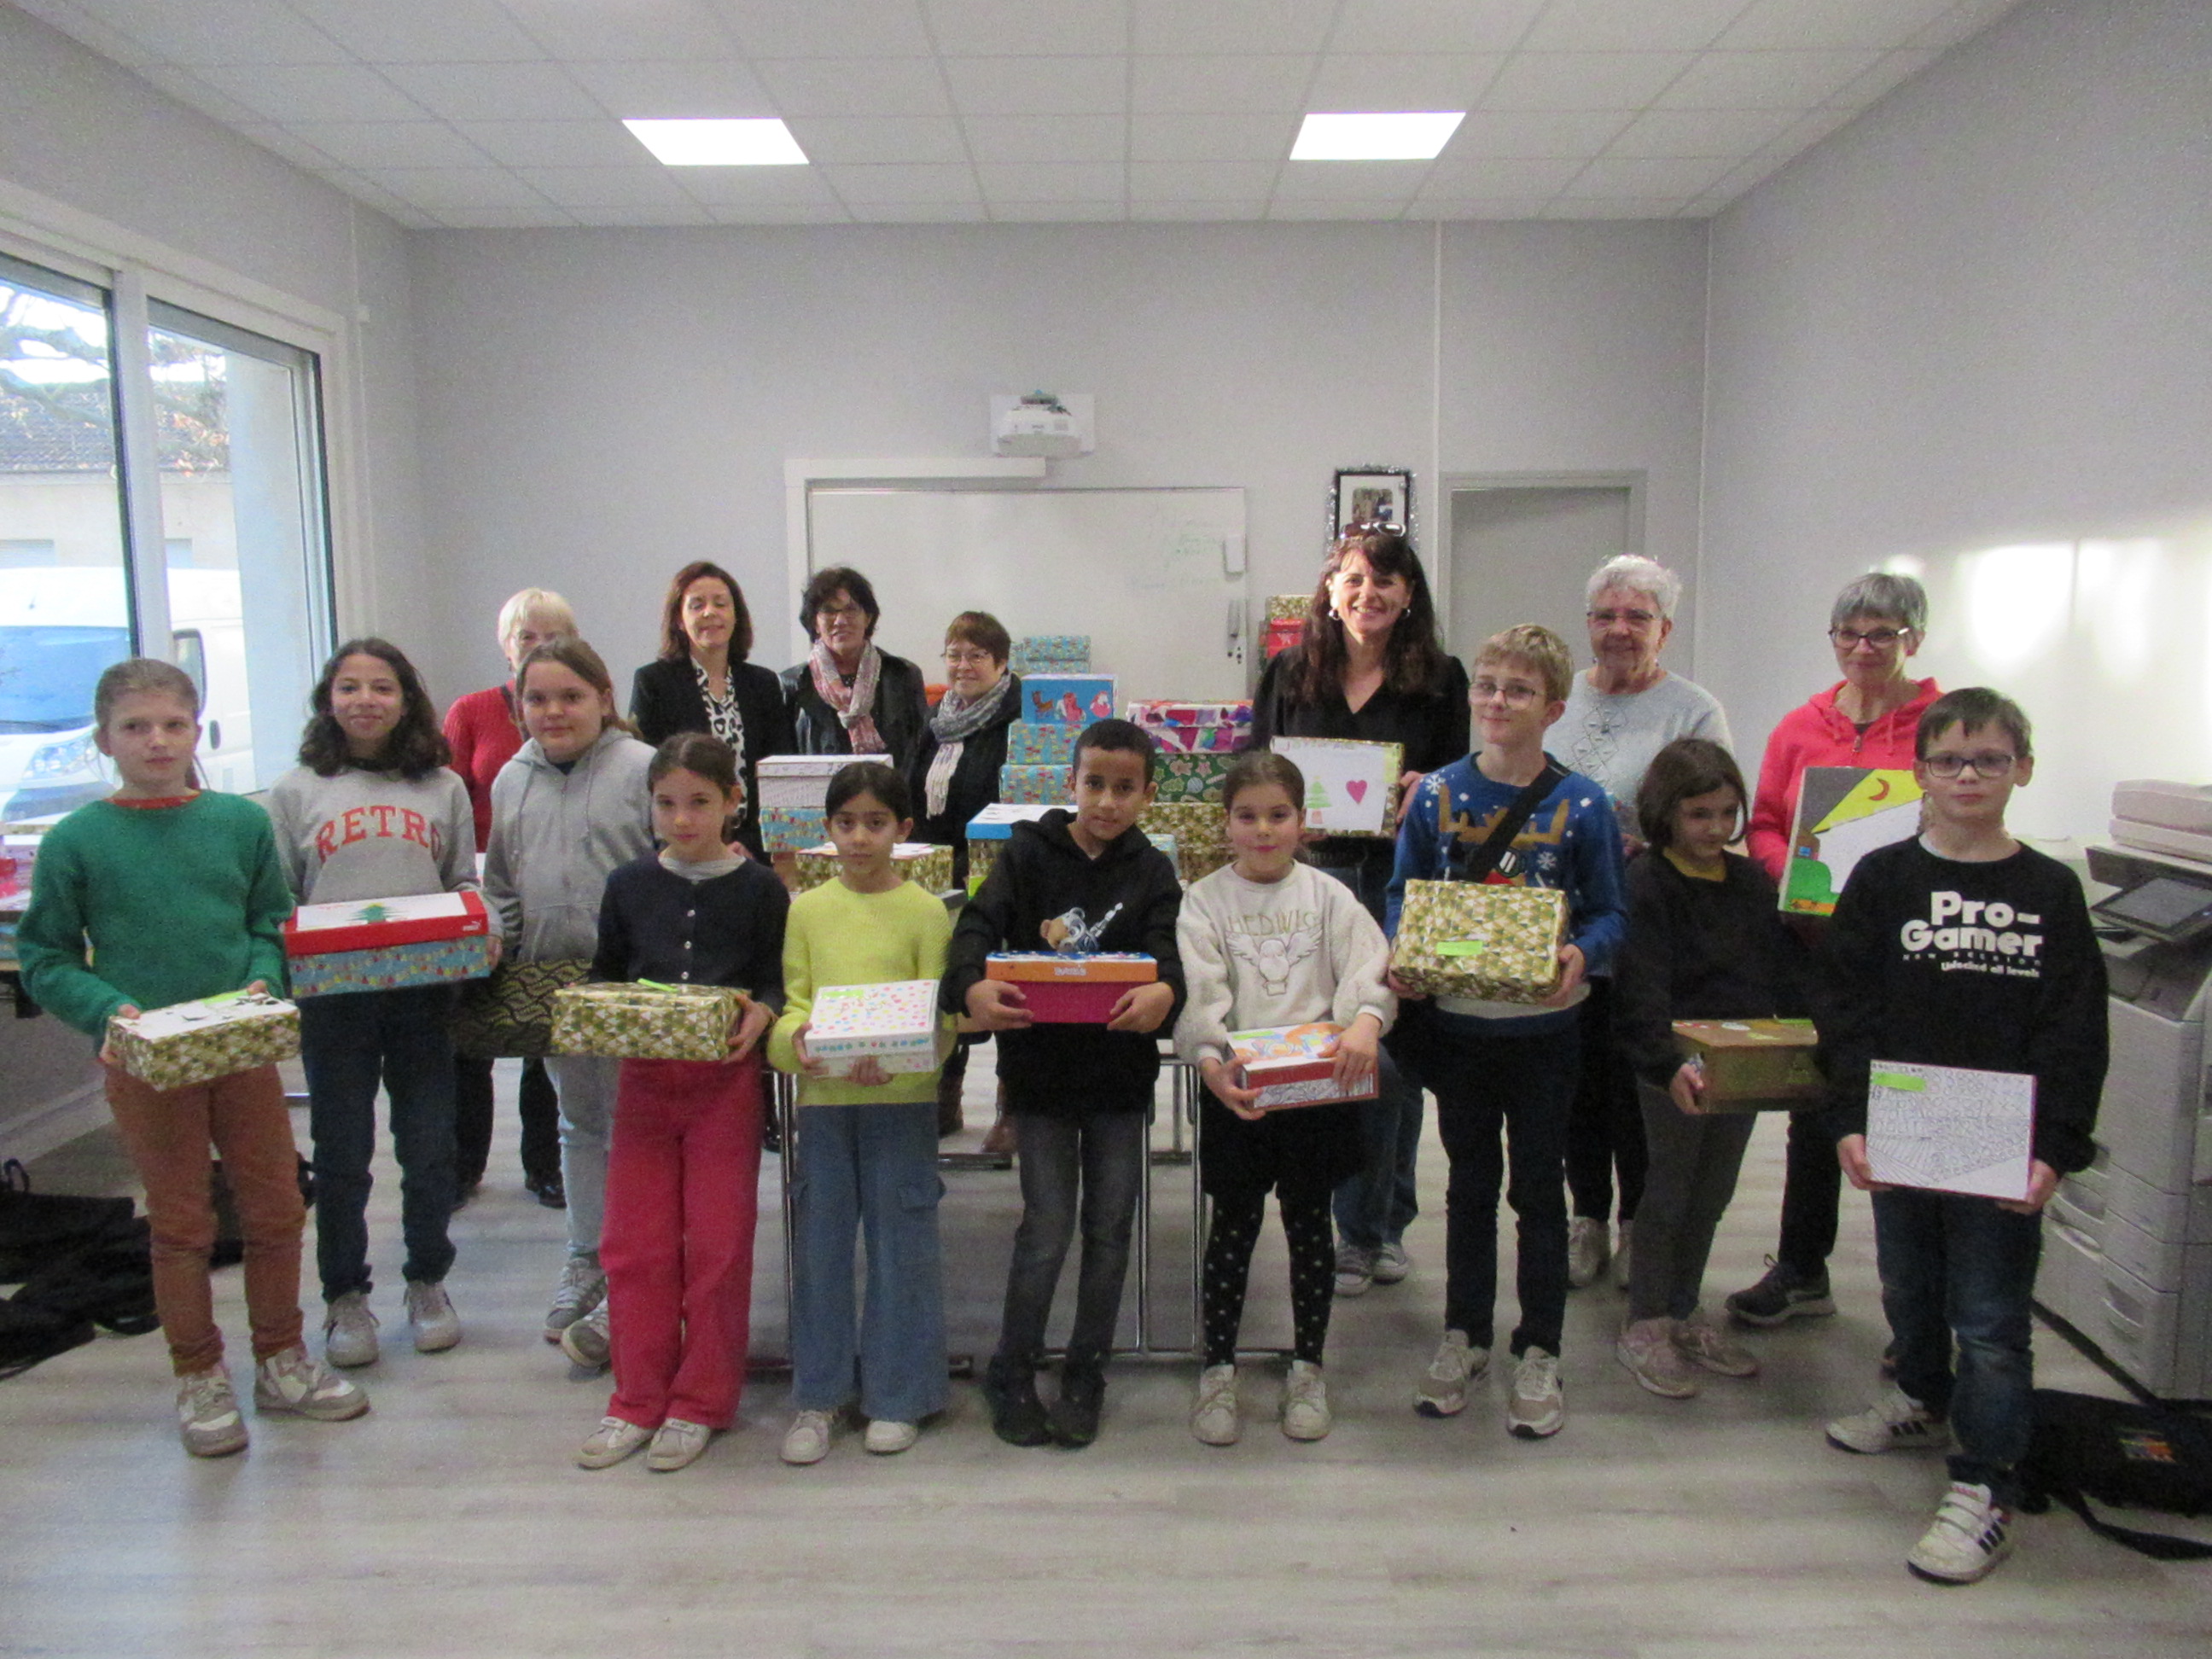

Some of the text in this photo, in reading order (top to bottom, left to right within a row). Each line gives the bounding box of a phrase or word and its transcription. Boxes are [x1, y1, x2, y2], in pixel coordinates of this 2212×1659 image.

[316, 805, 440, 864] RETRO
[1930, 890, 2040, 927] Pro-
[1901, 919, 2043, 957] Gamer
